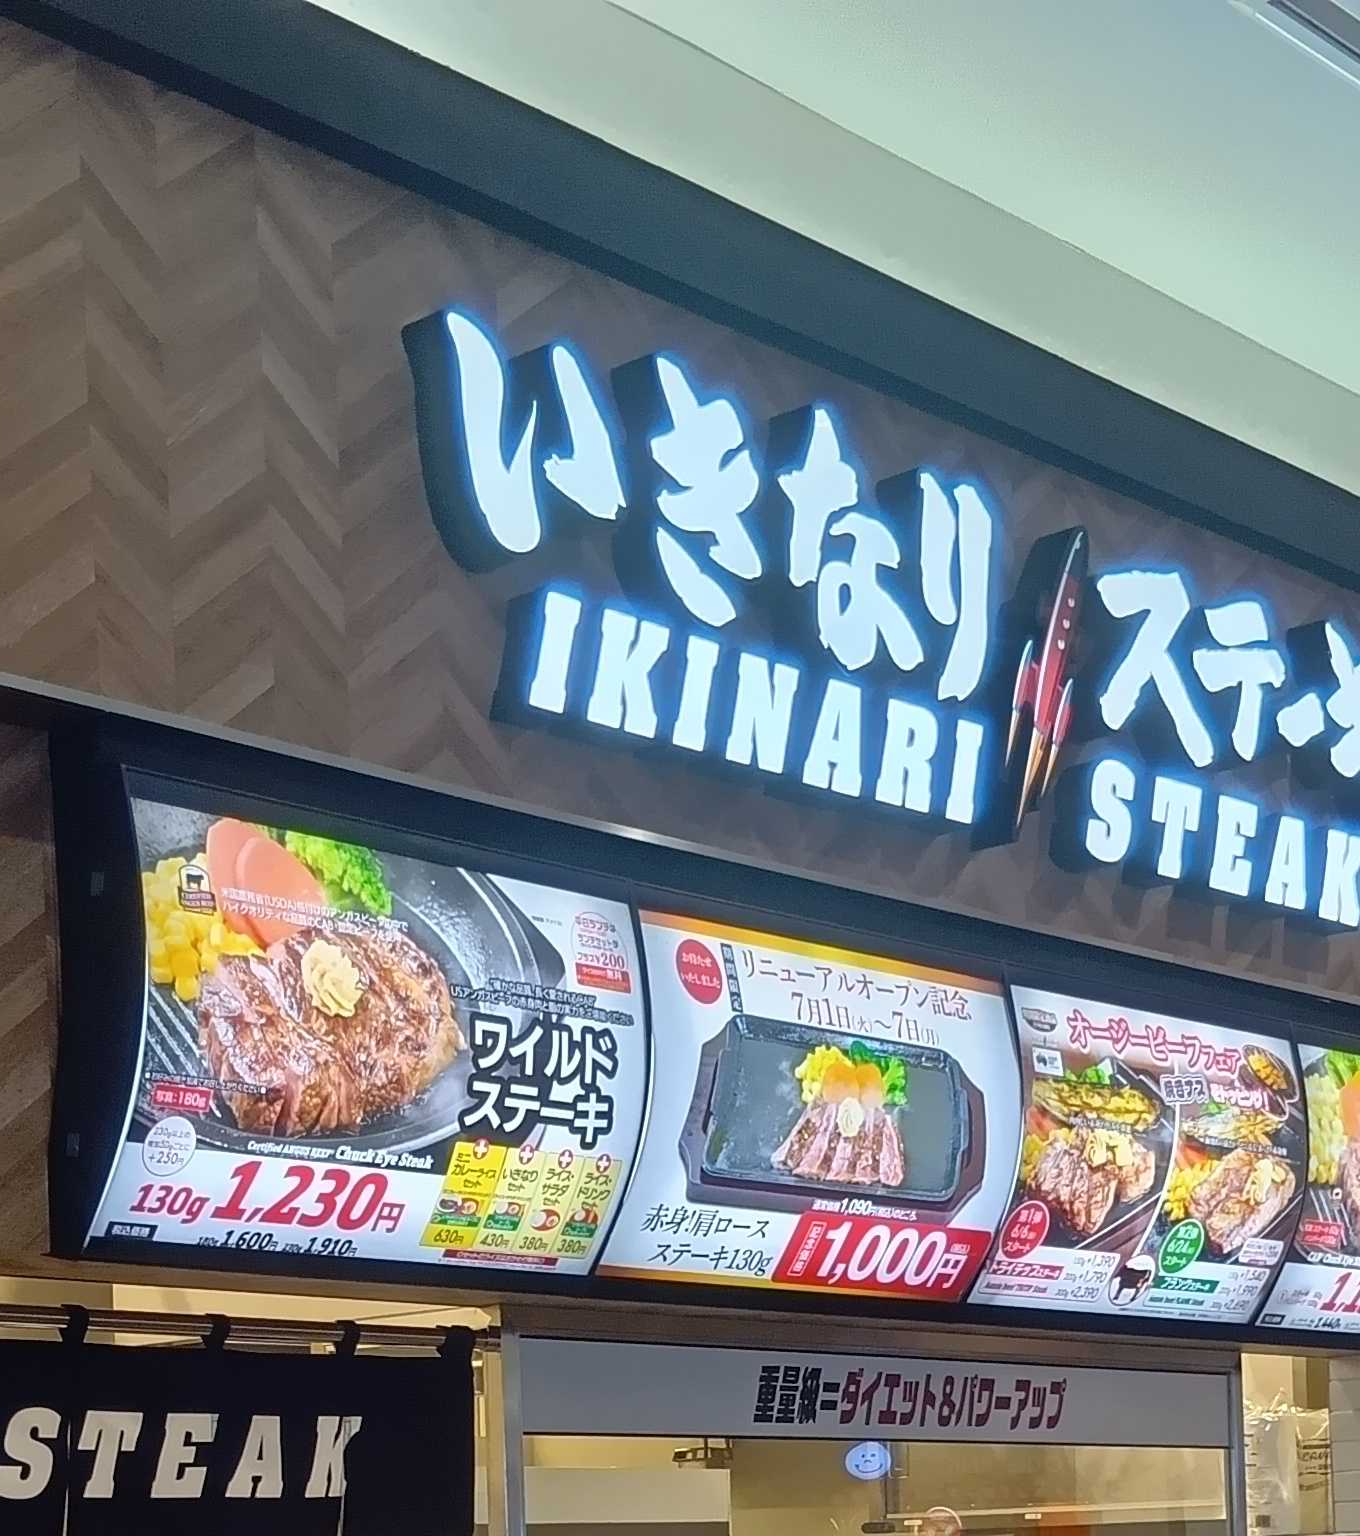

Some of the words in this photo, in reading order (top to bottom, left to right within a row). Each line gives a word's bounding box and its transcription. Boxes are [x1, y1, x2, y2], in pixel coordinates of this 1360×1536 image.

[446, 311, 993, 700] いきなり
[529, 591, 984, 825] IKINARI
[742, 949, 973, 1021] リニューアルオープン記念
[471, 1014, 618, 1080] ワイルド
[463, 1078, 610, 1143] ステーキ
[335, 1145, 373, 1163] Chuck
[375, 1149, 398, 1169] Eye
[400, 1152, 434, 1170] Steak
[130, 1184, 211, 1224] 130g
[212, 1161, 406, 1233] 1,230円
[647, 1241, 773, 1276] ステーキ130g
[816, 1221, 968, 1290] 1,000円
